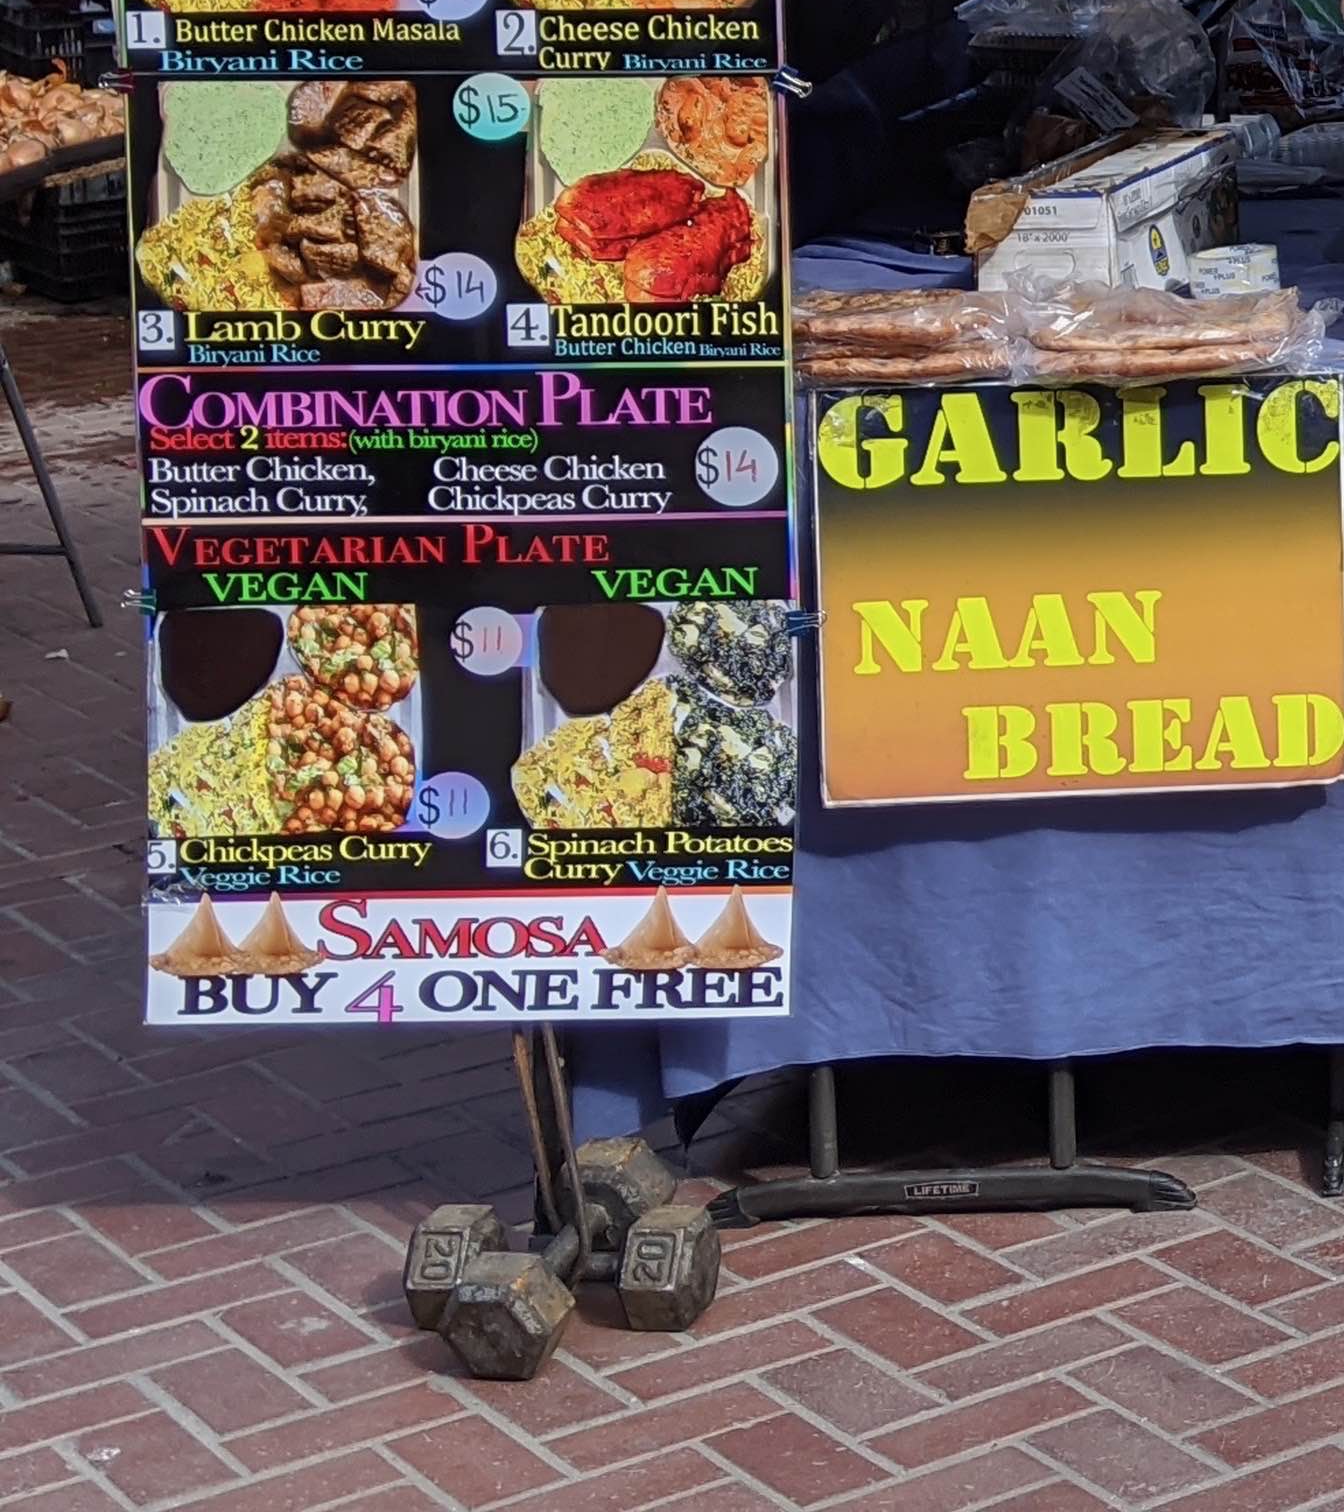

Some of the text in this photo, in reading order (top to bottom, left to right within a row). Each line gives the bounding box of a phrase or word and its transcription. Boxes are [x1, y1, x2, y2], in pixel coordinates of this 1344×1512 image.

[130, 12, 460, 46] 1. Butter Chicken Masala
[141, 312, 426, 349] 3. Lamb Curry
[139, 372, 711, 430] COMBINATION PLATE
[817, 378, 1341, 490] GARLIC
[433, 456, 665, 481] Cheese Chicken
[150, 523, 610, 566] VEGETARIAN PLATE
[204, 571, 369, 603] VEGAN
[852, 589, 1162, 676] NAAN
[146, 835, 432, 878] 5. Chickpeas Curry
[179, 865, 340, 890] Veggie Rice
[316, 899, 609, 959] SAMOSA
[178, 967, 783, 1023] BUY 4 ONE FREE
[914, 1185, 971, 1196] LIFETIME
[634, 1240, 665, 1283] 20
